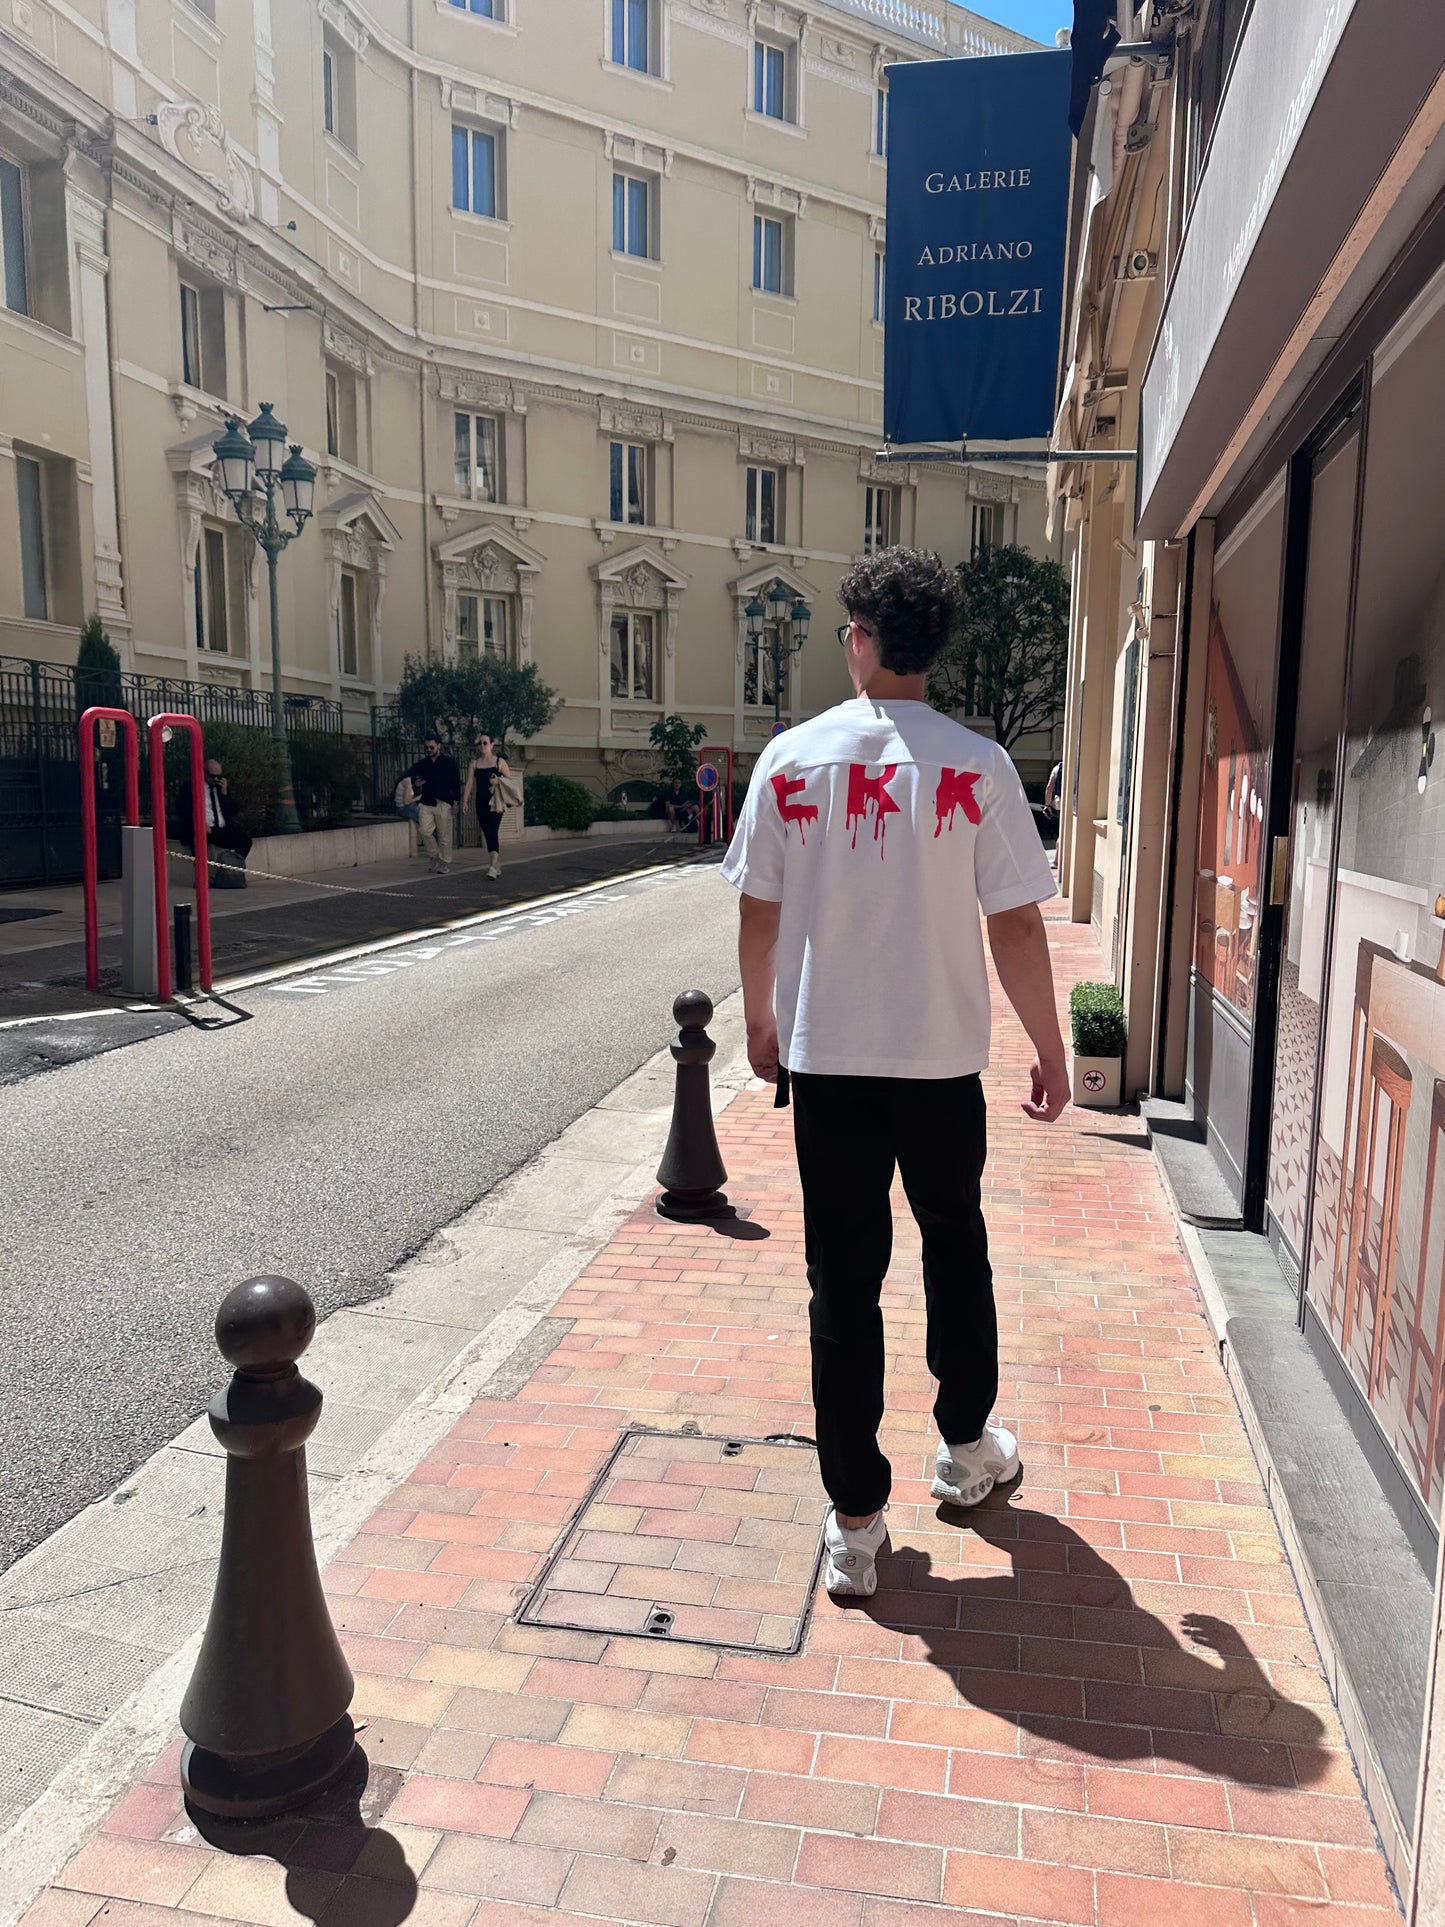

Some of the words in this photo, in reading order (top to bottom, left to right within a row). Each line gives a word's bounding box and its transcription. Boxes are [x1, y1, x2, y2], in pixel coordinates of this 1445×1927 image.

[925, 168, 1032, 194] GALERIE
[917, 241, 1034, 266] ADRIANO
[903, 288, 1044, 322] RIBOLZI
